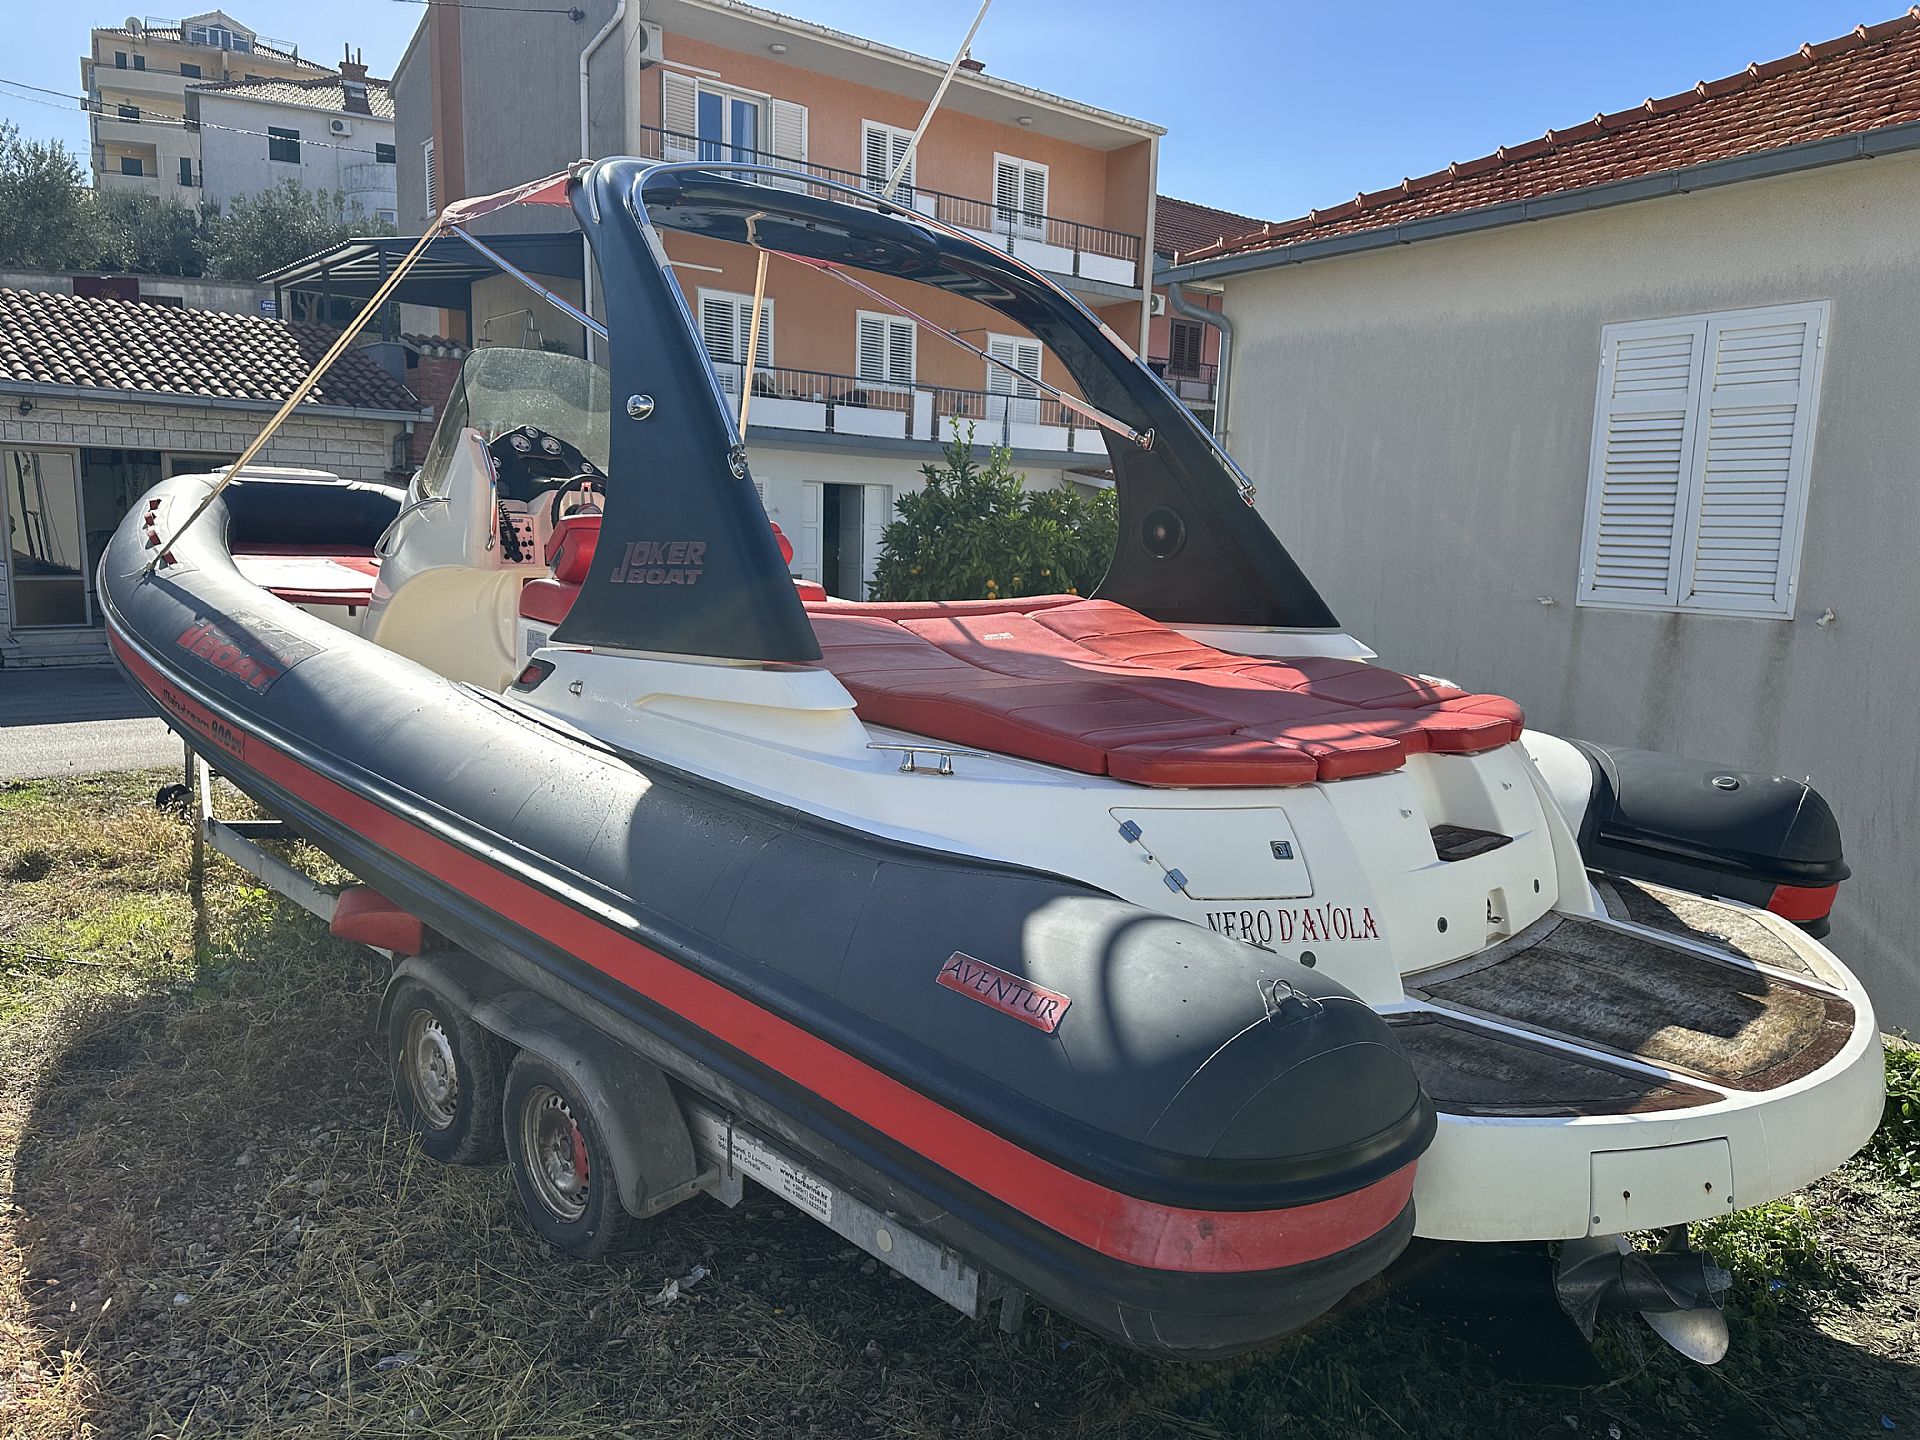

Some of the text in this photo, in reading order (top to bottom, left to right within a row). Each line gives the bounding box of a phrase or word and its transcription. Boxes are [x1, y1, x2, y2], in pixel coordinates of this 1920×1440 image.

[610, 541, 707, 583] JOKER
[626, 568, 704, 585] BOAT
[191, 635, 280, 688] BOAT
[1206, 901, 1381, 943] NERO D'AVOLA
[942, 959, 1059, 1027] AVENTUR
